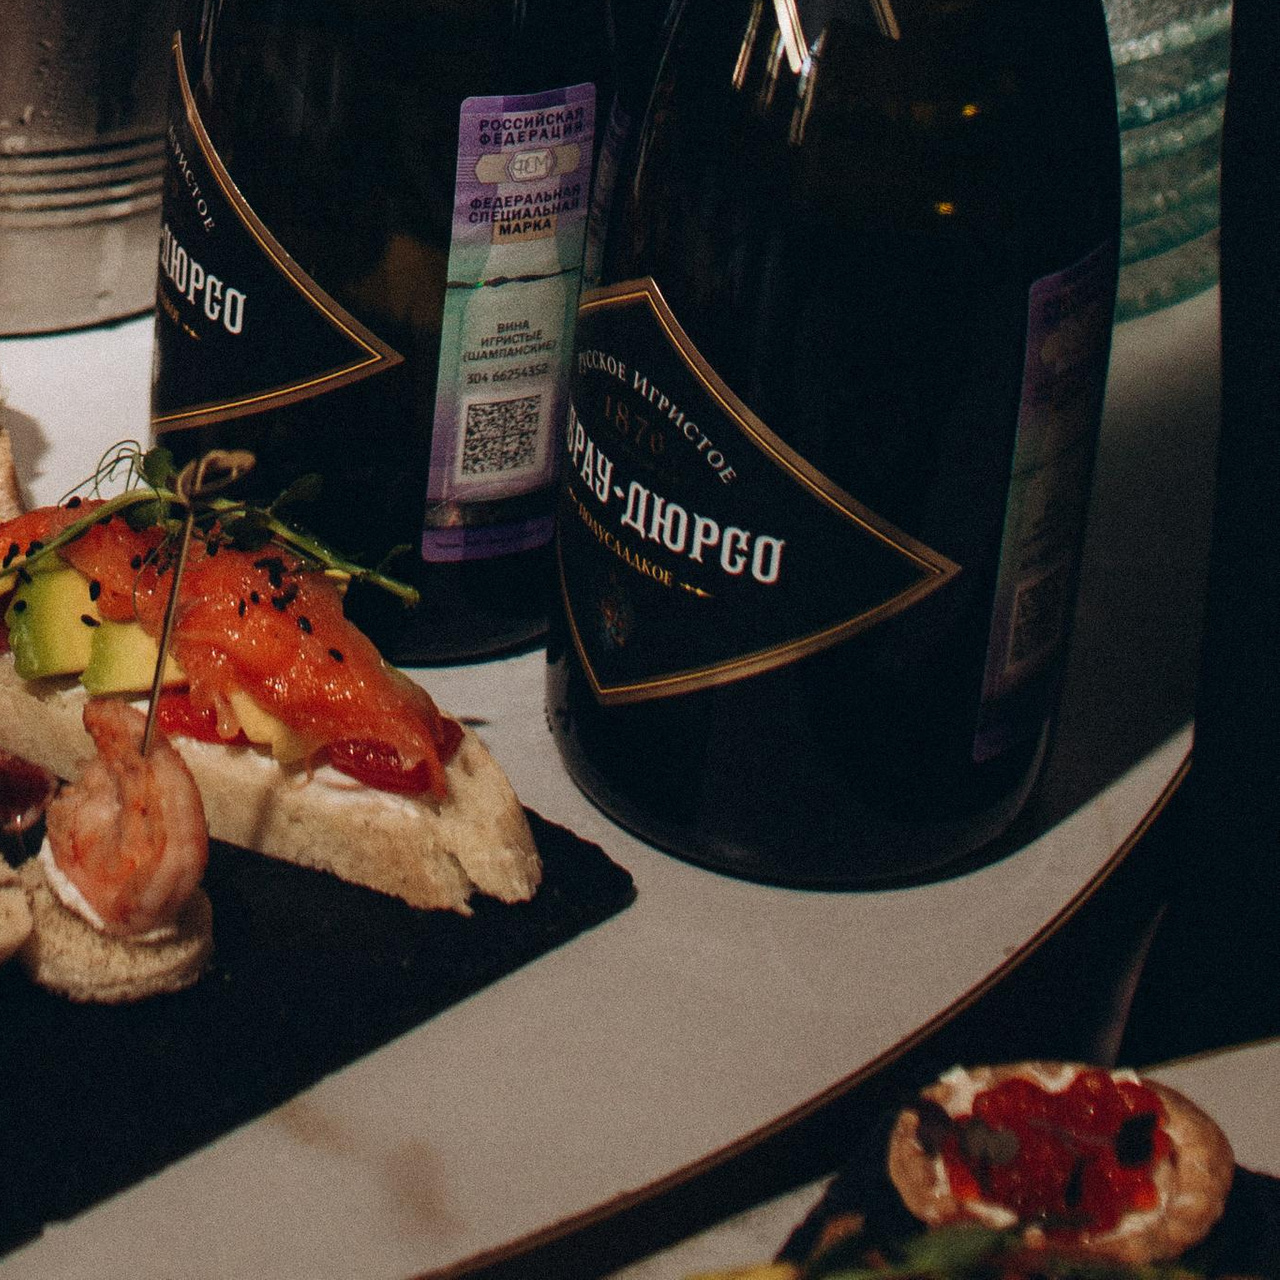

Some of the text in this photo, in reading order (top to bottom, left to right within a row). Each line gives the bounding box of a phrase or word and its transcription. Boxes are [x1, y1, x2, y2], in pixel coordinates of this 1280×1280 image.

[480, 107, 584, 132] РОССИЙСКАЯ
[479, 122, 583, 146] ФЕДЕРАЦИЯ
[470, 185, 581, 210] ФЕДЕРАЛЬНАЯ
[469, 199, 580, 223] СПЕЦИАЛЬНАЯ
[499, 218, 552, 235] МАРКА
[480, 329, 543, 347] ИГРИСТЫЕ
[497, 320, 530, 333] ВИНА
[633, 370, 738, 485] ИГРИСТОЕ
[566, 403, 788, 585] БРАУ-ДЮРСО
